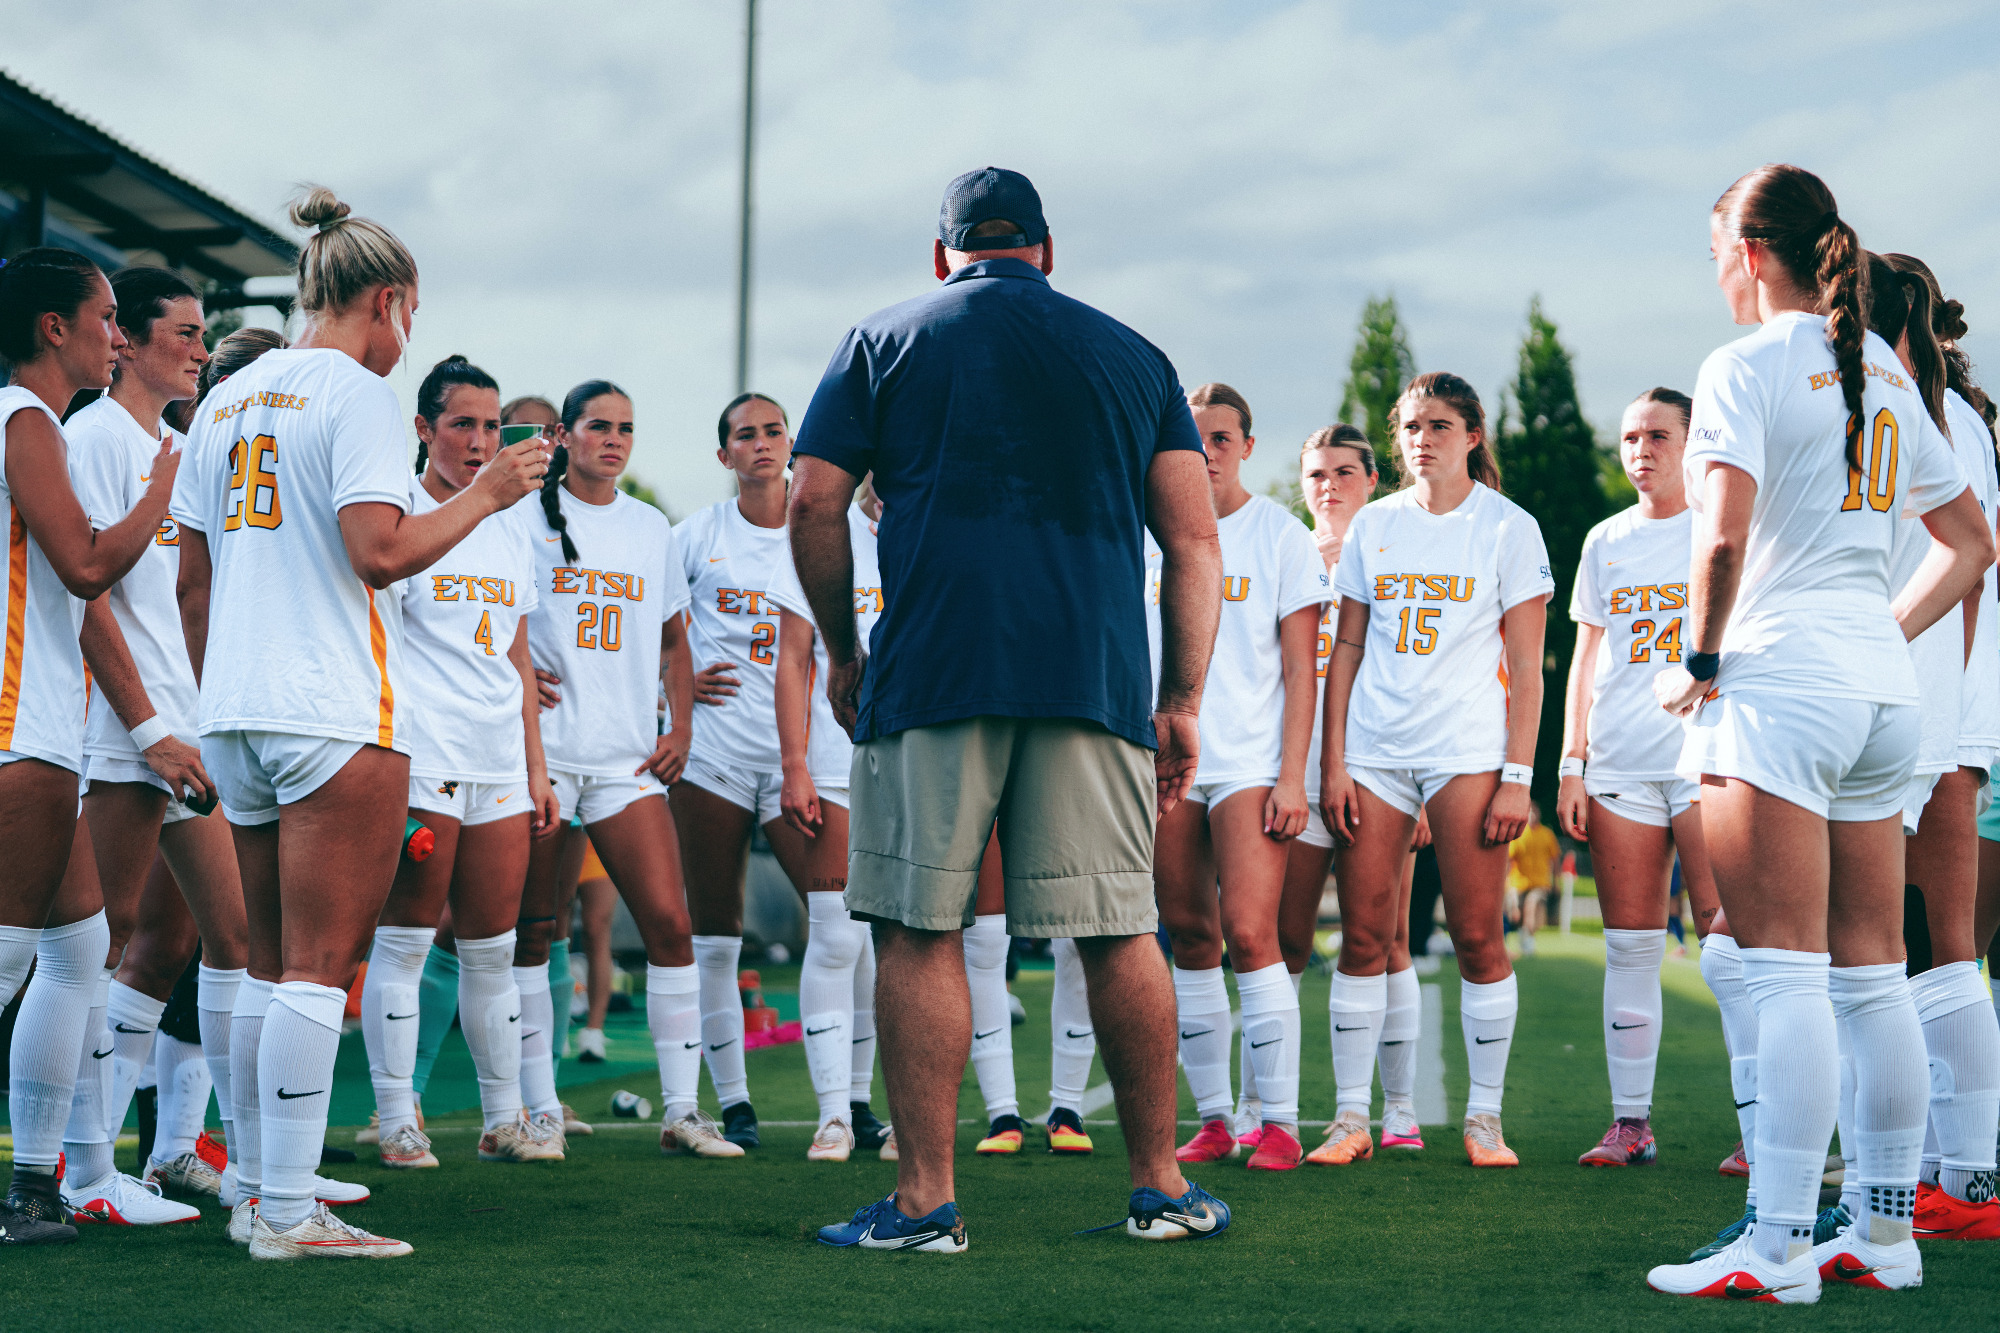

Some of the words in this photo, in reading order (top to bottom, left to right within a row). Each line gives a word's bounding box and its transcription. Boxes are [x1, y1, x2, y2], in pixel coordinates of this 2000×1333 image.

[224, 433, 283, 532] 26
[1840, 407, 1899, 513] 10
[431, 574, 516, 607] ETSU
[551, 567, 645, 602] ETSU
[1374, 573, 1476, 602] ETSU
[474, 609, 497, 656] 4
[577, 601, 623, 651] 20
[750, 622, 776, 665] 2
[1395, 606, 1442, 655] 15
[1628, 617, 1682, 664] 24
